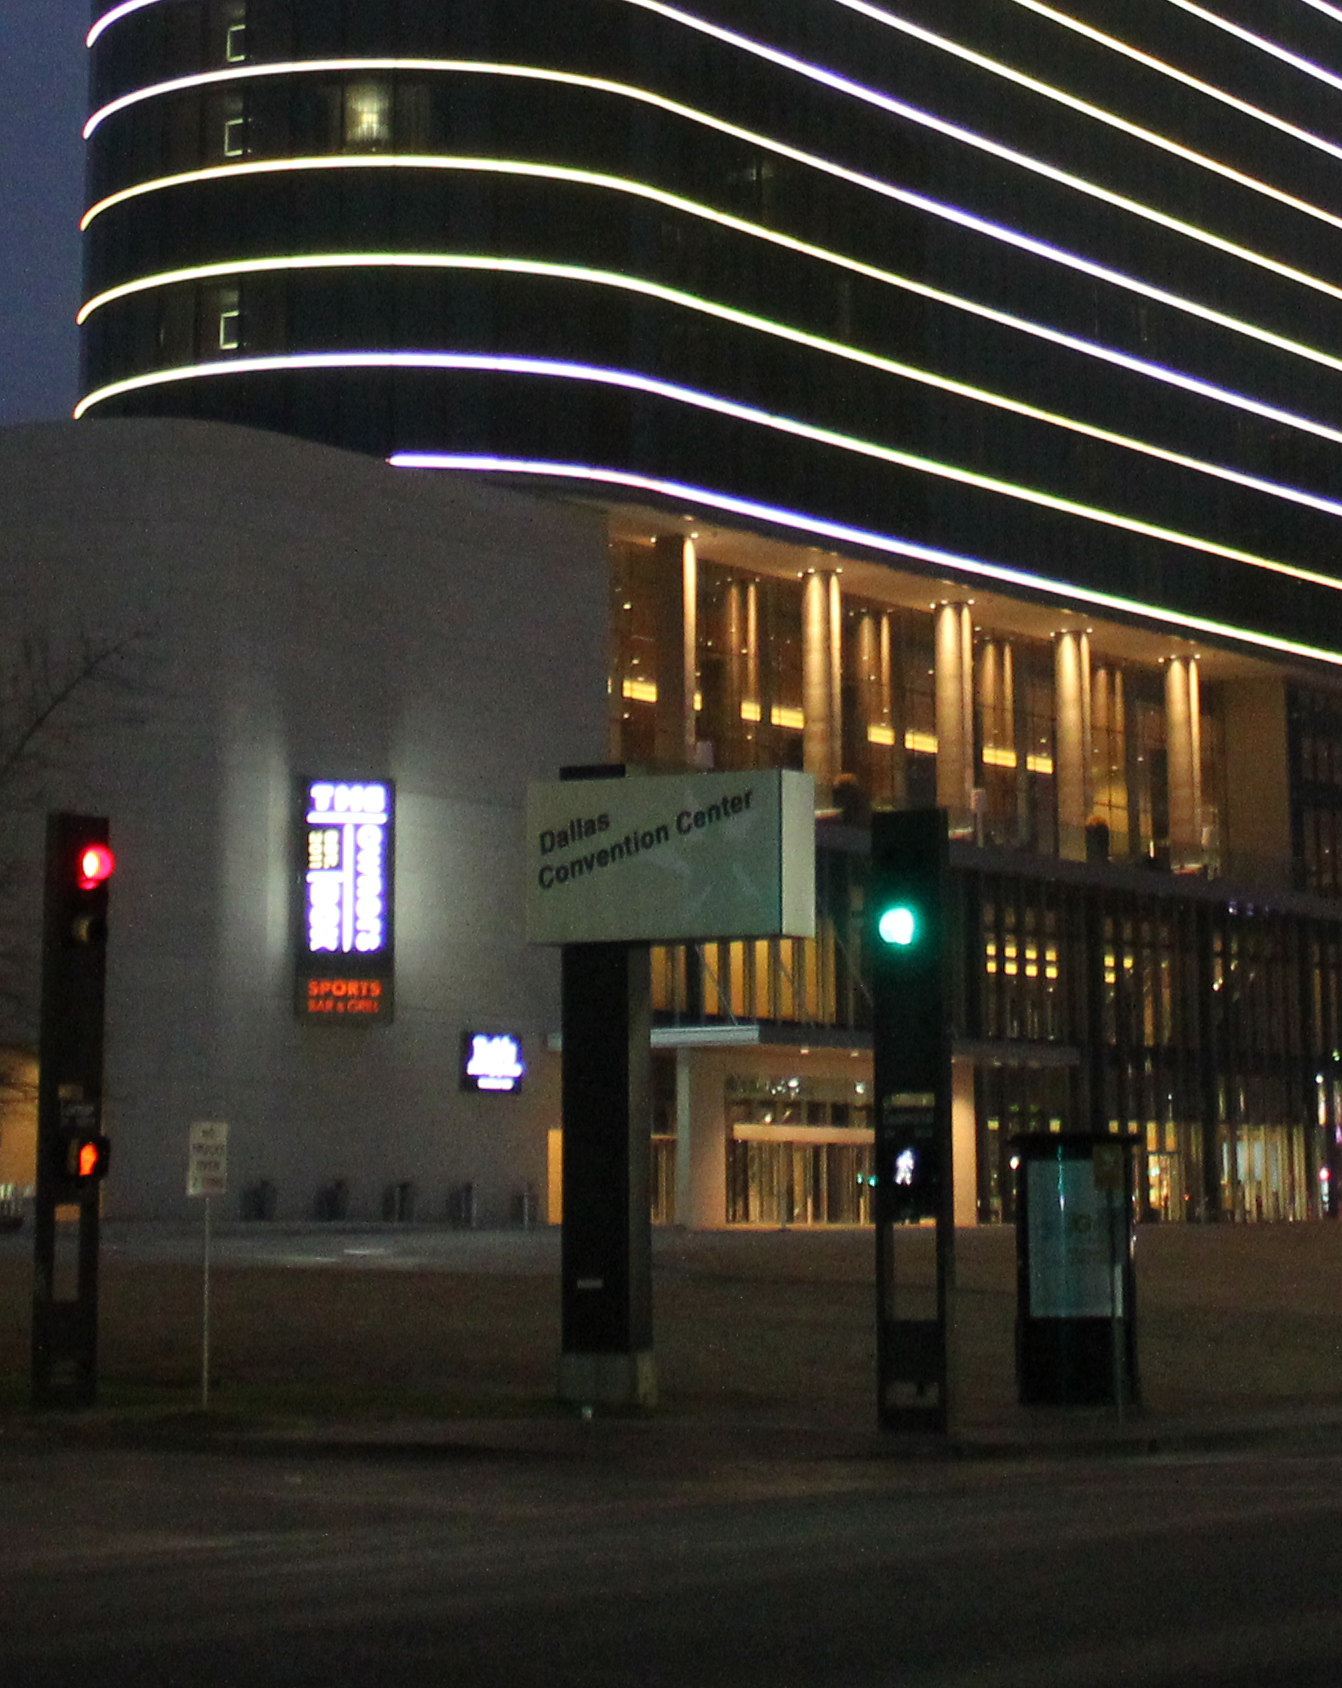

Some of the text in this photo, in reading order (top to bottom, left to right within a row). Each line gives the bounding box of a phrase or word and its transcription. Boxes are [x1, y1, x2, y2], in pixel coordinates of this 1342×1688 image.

[538, 789, 753, 889] Convention Center
[540, 813, 610, 855] Dallas
[308, 979, 382, 997] SPORTS
[308, 999, 335, 1013] BAR
